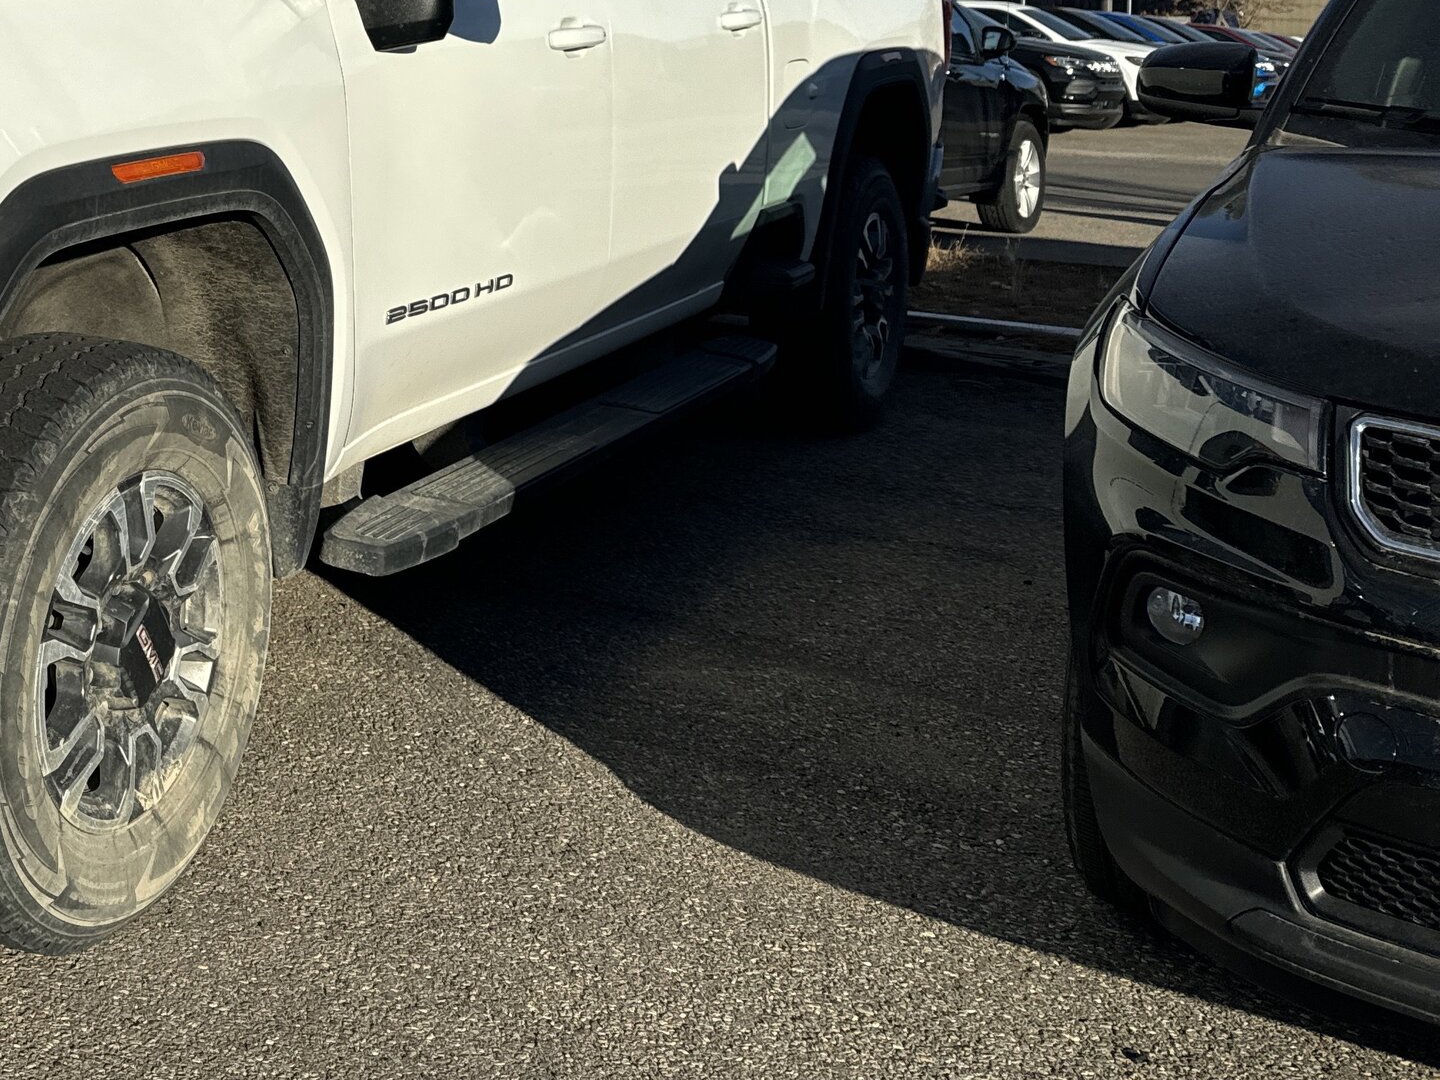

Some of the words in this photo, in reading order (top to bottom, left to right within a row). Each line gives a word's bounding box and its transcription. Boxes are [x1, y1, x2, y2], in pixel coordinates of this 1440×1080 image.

[385, 287, 470, 326] 2500
[474, 273, 513, 298] HD
[135, 623, 164, 684] GMC
